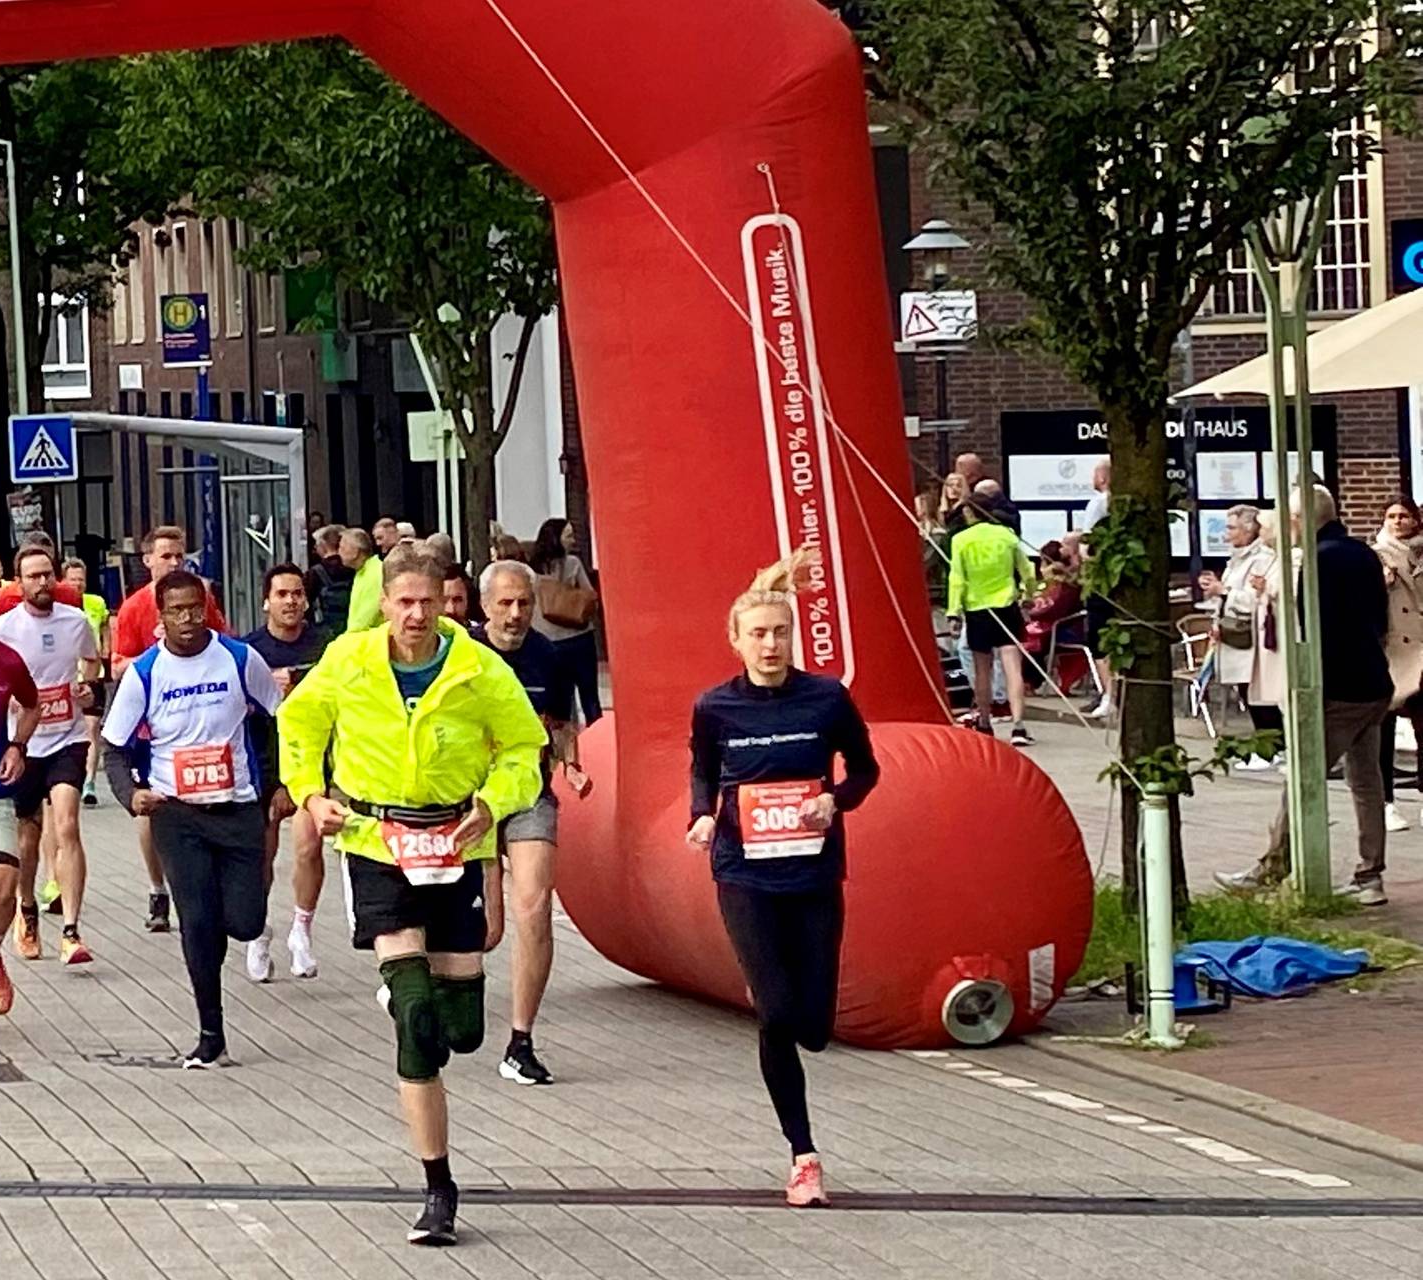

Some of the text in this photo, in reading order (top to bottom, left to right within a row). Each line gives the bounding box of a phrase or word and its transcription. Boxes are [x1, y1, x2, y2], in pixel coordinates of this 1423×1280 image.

[765, 241, 792, 318] Musik.
[199, 304, 206, 320] 1
[778, 321, 801, 386] beste
[783, 389, 806, 423] die
[750, 806, 800, 832] 306
